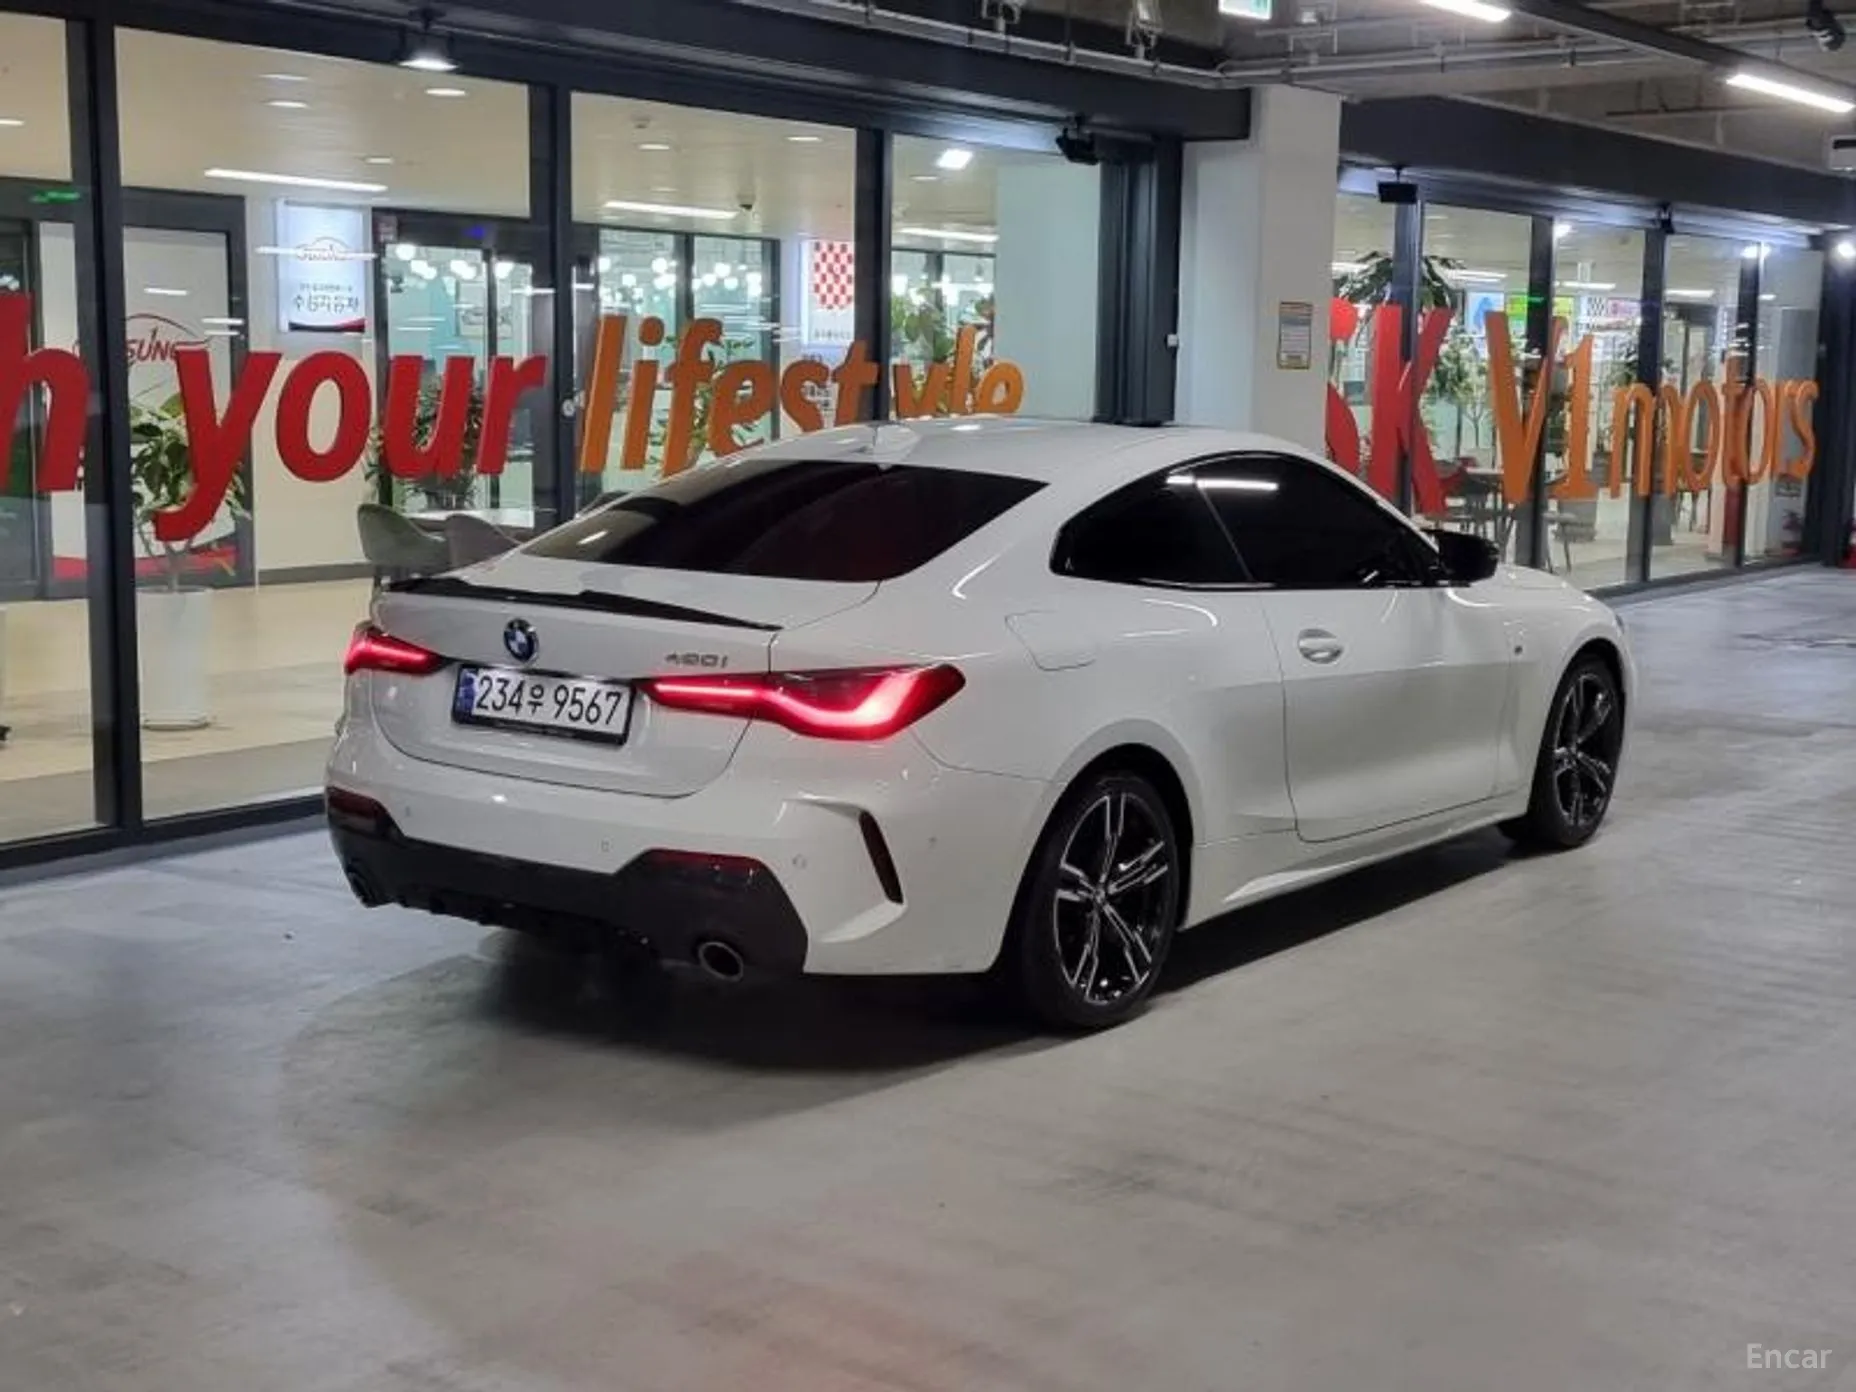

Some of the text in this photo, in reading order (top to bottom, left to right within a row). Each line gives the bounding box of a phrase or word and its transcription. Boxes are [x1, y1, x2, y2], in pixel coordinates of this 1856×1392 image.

[152, 348, 547, 541] your
[475, 675, 622, 726] 234우 9567
